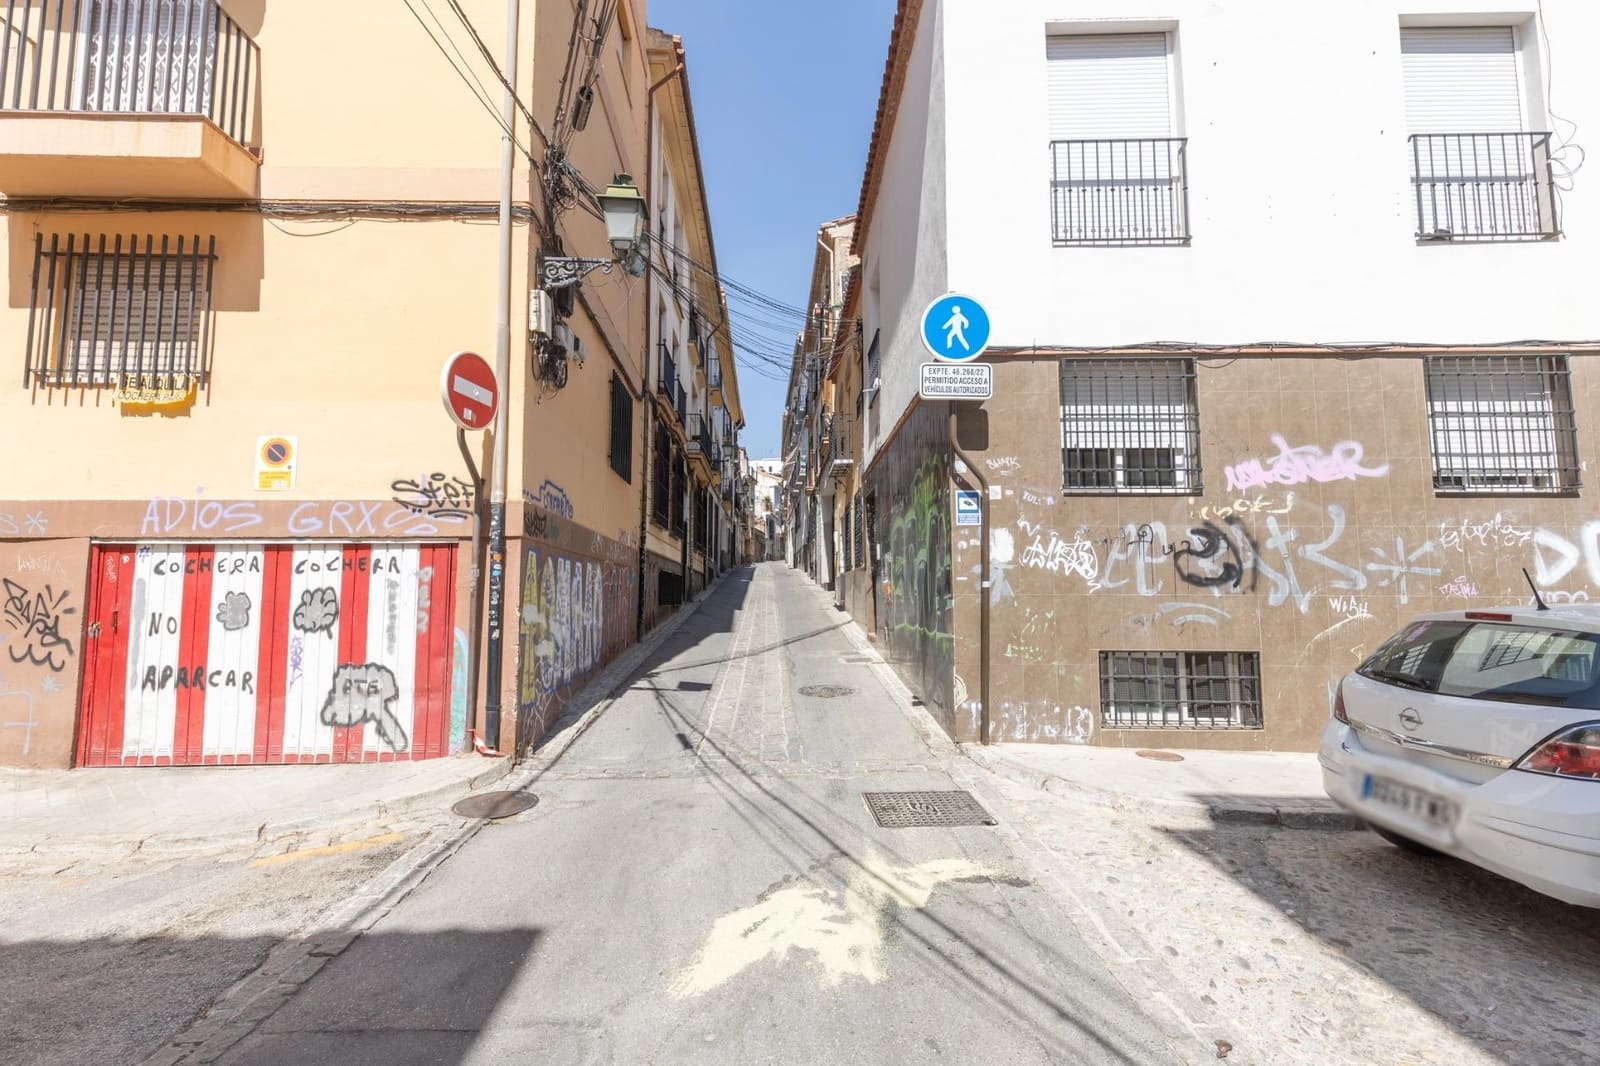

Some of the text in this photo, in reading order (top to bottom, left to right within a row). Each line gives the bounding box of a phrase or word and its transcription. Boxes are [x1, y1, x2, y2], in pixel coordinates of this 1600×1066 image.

[924, 376, 958, 385] PERMITIDO
[959, 377, 983, 385] ACCESO
[953, 386, 988, 394] AUTORIZADOS
[288, 501, 376, 535] GRX
[153, 556, 400, 576] COCHERA COCHERA
[149, 612, 177, 636] NO
[141, 665, 254, 695] APARCAR
